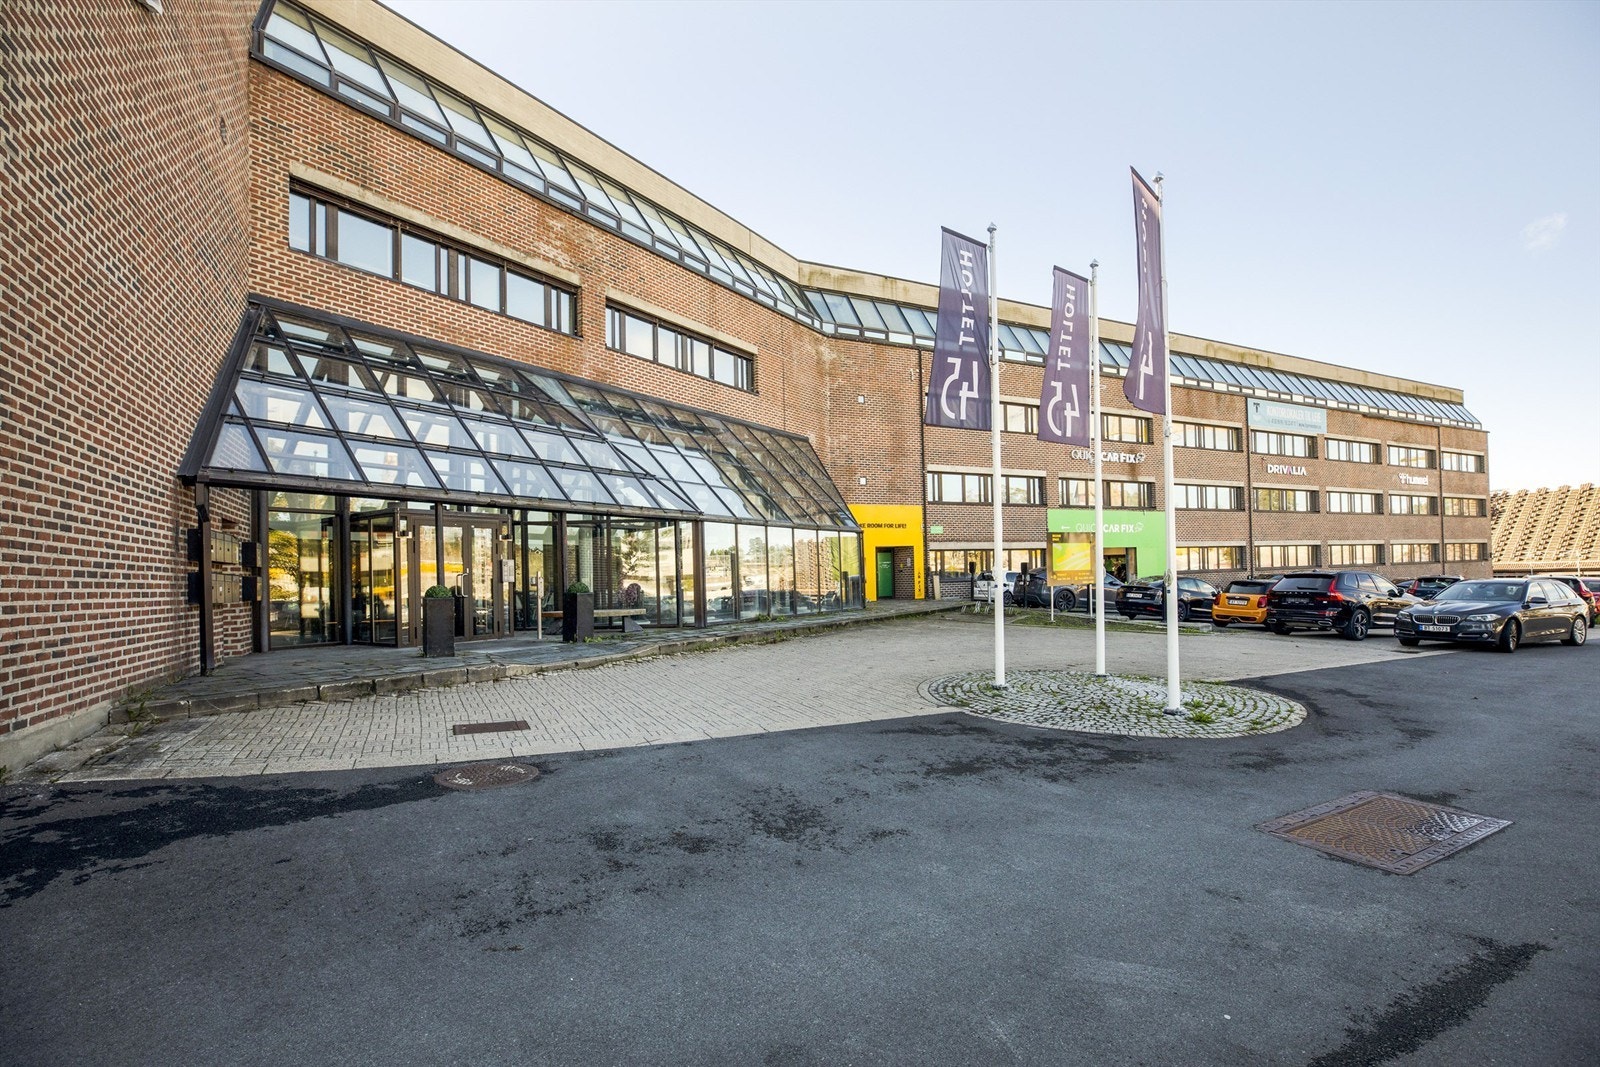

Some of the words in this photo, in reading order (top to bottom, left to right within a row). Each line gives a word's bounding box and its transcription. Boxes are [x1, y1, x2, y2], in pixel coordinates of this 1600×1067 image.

[1267, 464, 1307, 476] DRIVALIA
[1075, 523, 1096, 532] QUIC
[1103, 523, 1120, 533] CAR
[1121, 524, 1135, 533] FIX
